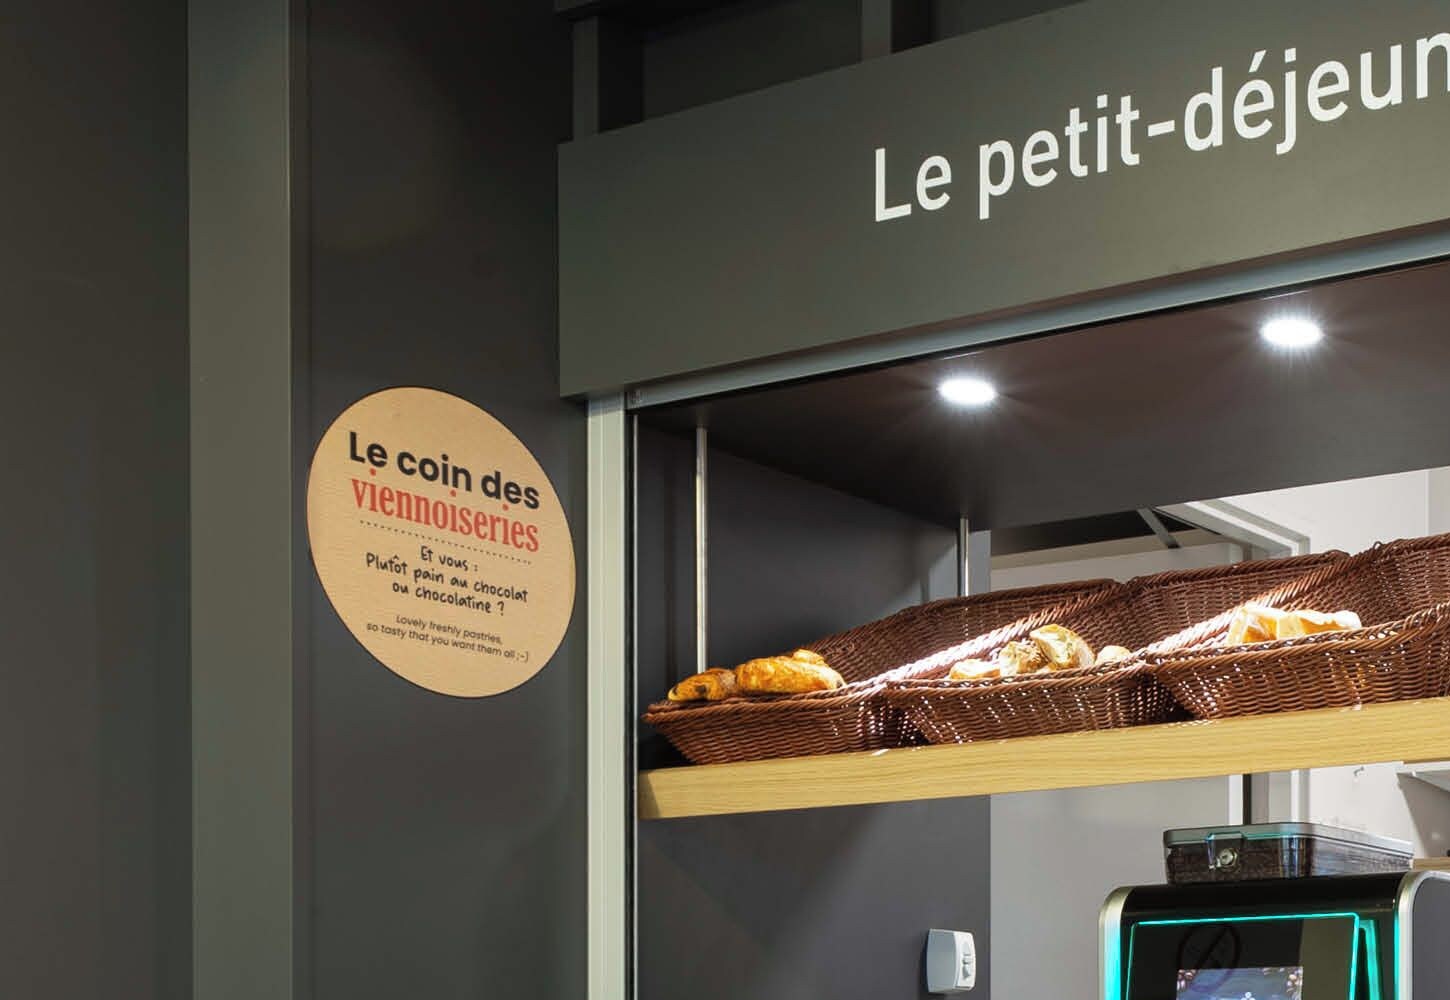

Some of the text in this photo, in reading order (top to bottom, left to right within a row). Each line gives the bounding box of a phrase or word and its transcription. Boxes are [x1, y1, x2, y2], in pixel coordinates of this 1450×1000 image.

[874, 147, 951, 223] Le
[349, 431, 540, 510] Le coin des
[350, 467, 540, 553] viennoiseries
[366, 552, 529, 603] Plutôt pain au chocolat
[420, 545, 433, 562] Et
[439, 553, 469, 572] vous
[392, 582, 409, 594] ou
[415, 586, 492, 614] chocolatine
[366, 622, 379, 632] so
[381, 624, 407, 639] tasty
[408, 629, 430, 642] that
[431, 634, 449, 646] you
[451, 638, 475, 651] want
[477, 642, 502, 657] them
[395, 615, 427, 629] Lovely
